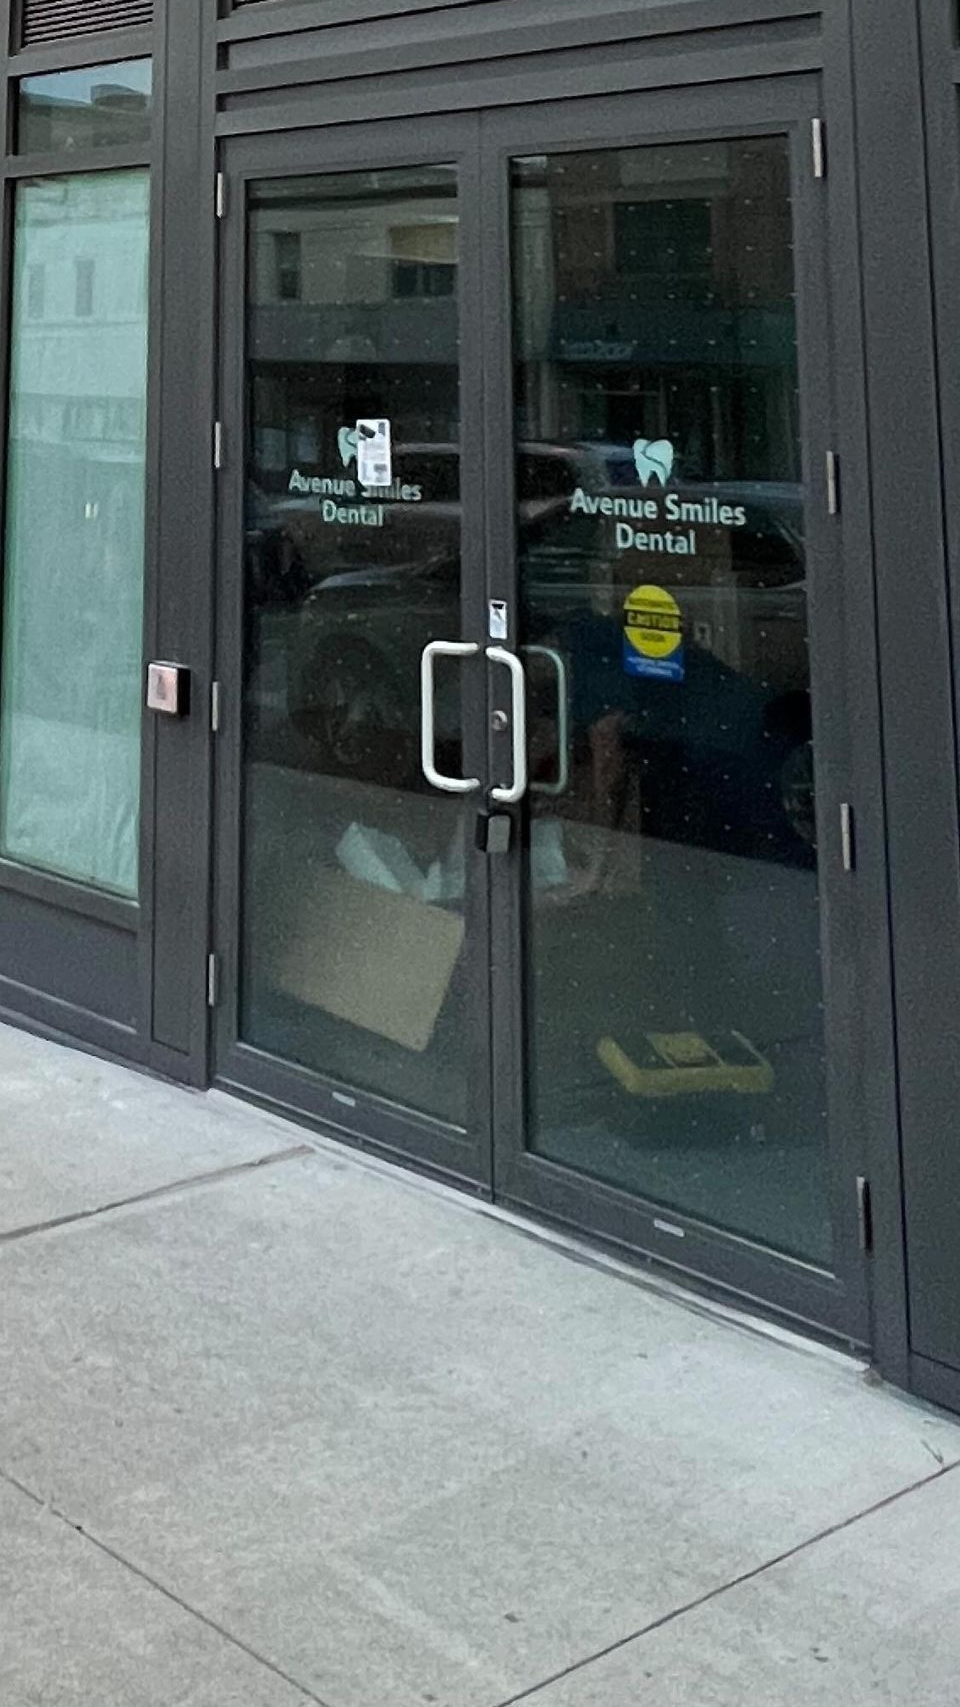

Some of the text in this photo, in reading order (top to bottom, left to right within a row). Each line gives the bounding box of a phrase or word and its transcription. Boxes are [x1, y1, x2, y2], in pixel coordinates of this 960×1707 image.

[288, 468, 356, 497] Avenue
[322, 499, 384, 527] Dental
[570, 487, 746, 526] Avenue Smiles
[615, 522, 697, 555] Dental
